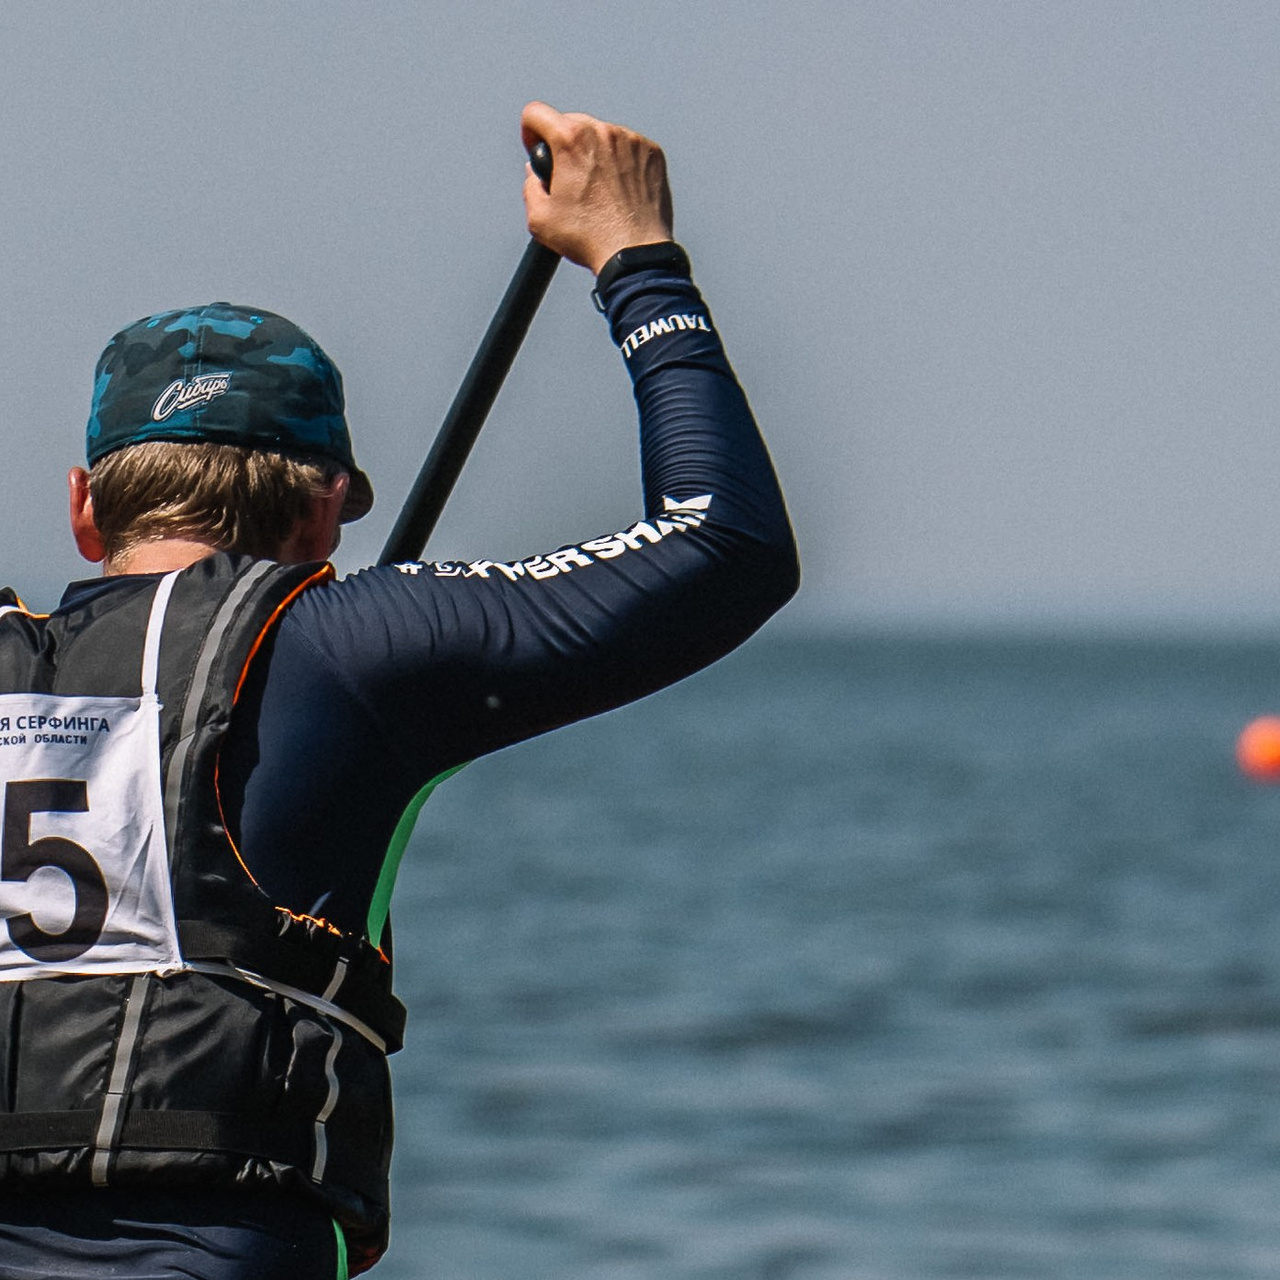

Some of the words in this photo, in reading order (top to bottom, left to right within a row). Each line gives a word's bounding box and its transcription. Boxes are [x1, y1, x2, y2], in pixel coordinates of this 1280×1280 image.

[622, 313, 712, 359] TAUWELL
[151, 371, 234, 422] Сибирь
[16, 714, 111, 733] СЕРФИНГА
[33, 732, 88, 746] ОБЛАСТИ
